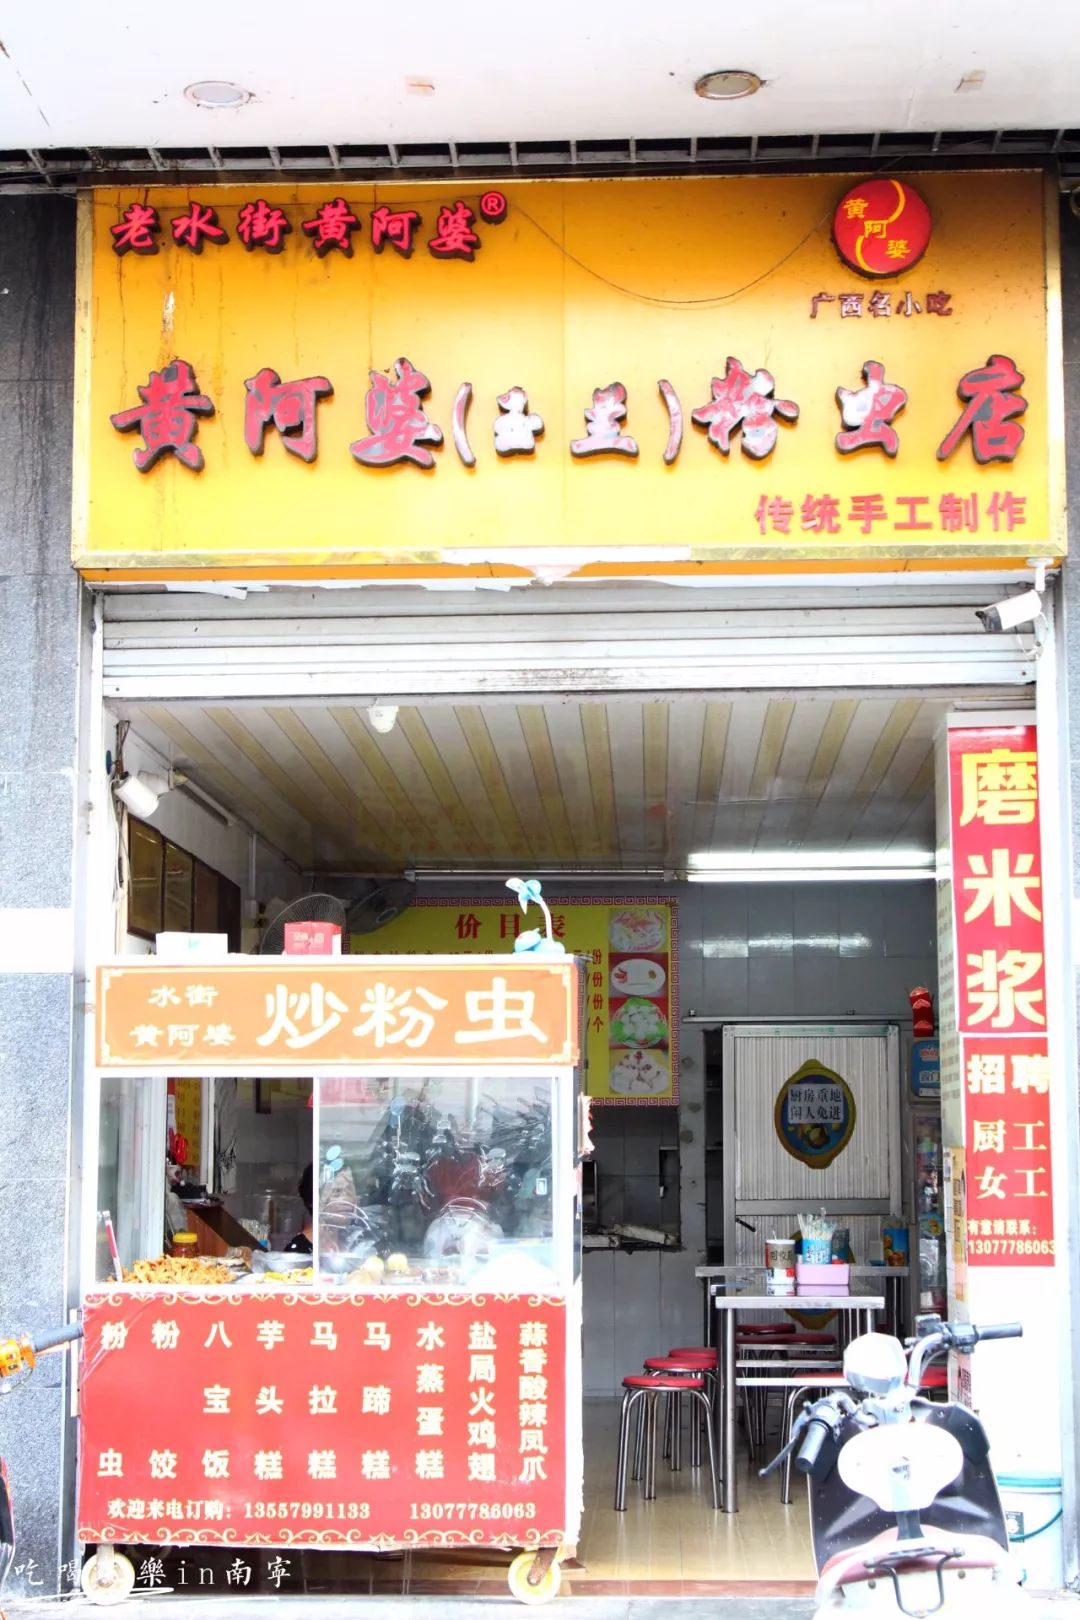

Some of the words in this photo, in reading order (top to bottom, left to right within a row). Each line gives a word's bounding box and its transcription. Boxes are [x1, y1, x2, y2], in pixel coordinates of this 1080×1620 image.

[111, 198, 481, 262] 老水街黄阿婆
[843, 198, 911, 258] 黄阿婆
[809, 290, 953, 319] 广西名小吃
[754, 491, 1027, 533] 传统手工制作
[959, 748, 1046, 1028] 磨米浆
[456, 913, 566, 940] 价目表
[148, 984, 219, 1008] 水街
[257, 976, 549, 1049] 炒粉虫
[129, 1023, 237, 1048] 黄阿婆
[790, 1087, 841, 1102] 厨房重地
[967, 1054, 1051, 1095] 招聘
[790, 1104, 841, 1121] 闲人免进
[973, 1119, 1047, 1154] 厨工
[974, 1166, 1048, 1200] 女工
[968, 1239, 1056, 1255] 13077786063
[97, 1320, 129, 1478] 粉虫
[148, 1319, 181, 1479] 粉饺
[201, 1320, 233, 1479] 八宝饭
[254, 1319, 285, 1481] 芋头糕
[307, 1321, 338, 1480] 马拉糕
[361, 1321, 392, 1481] 马蹄糕
[415, 1320, 446, 1480] 水蒸蛋糕
[518, 1320, 548, 1482] 蒜香酸辣凤爪
[244, 1502, 371, 1520] 13557991133
[409, 1502, 536, 1520] 13077786063
